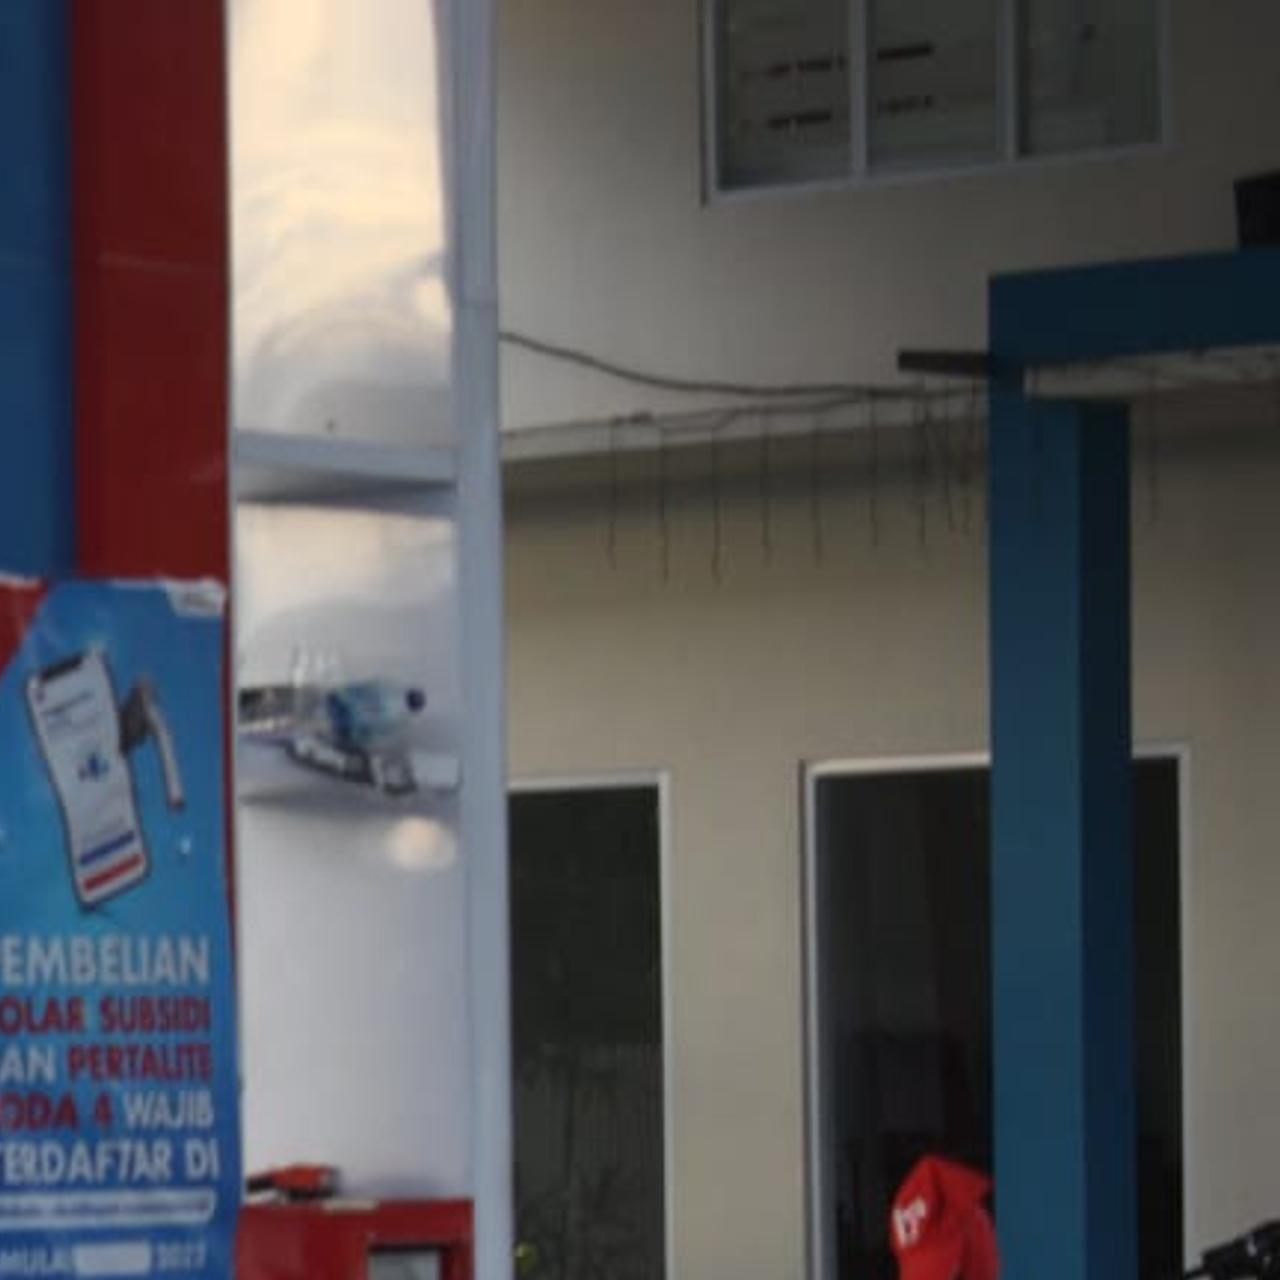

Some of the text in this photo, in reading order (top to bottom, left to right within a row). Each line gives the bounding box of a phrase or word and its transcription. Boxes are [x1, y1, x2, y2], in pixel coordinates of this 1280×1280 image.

[100, 996, 211, 1032] SUBSIDI
[68, 1043, 213, 1081] PERTALITE
[123, 1090, 215, 1127] WAJIB
[186, 1137, 220, 1178] DI
